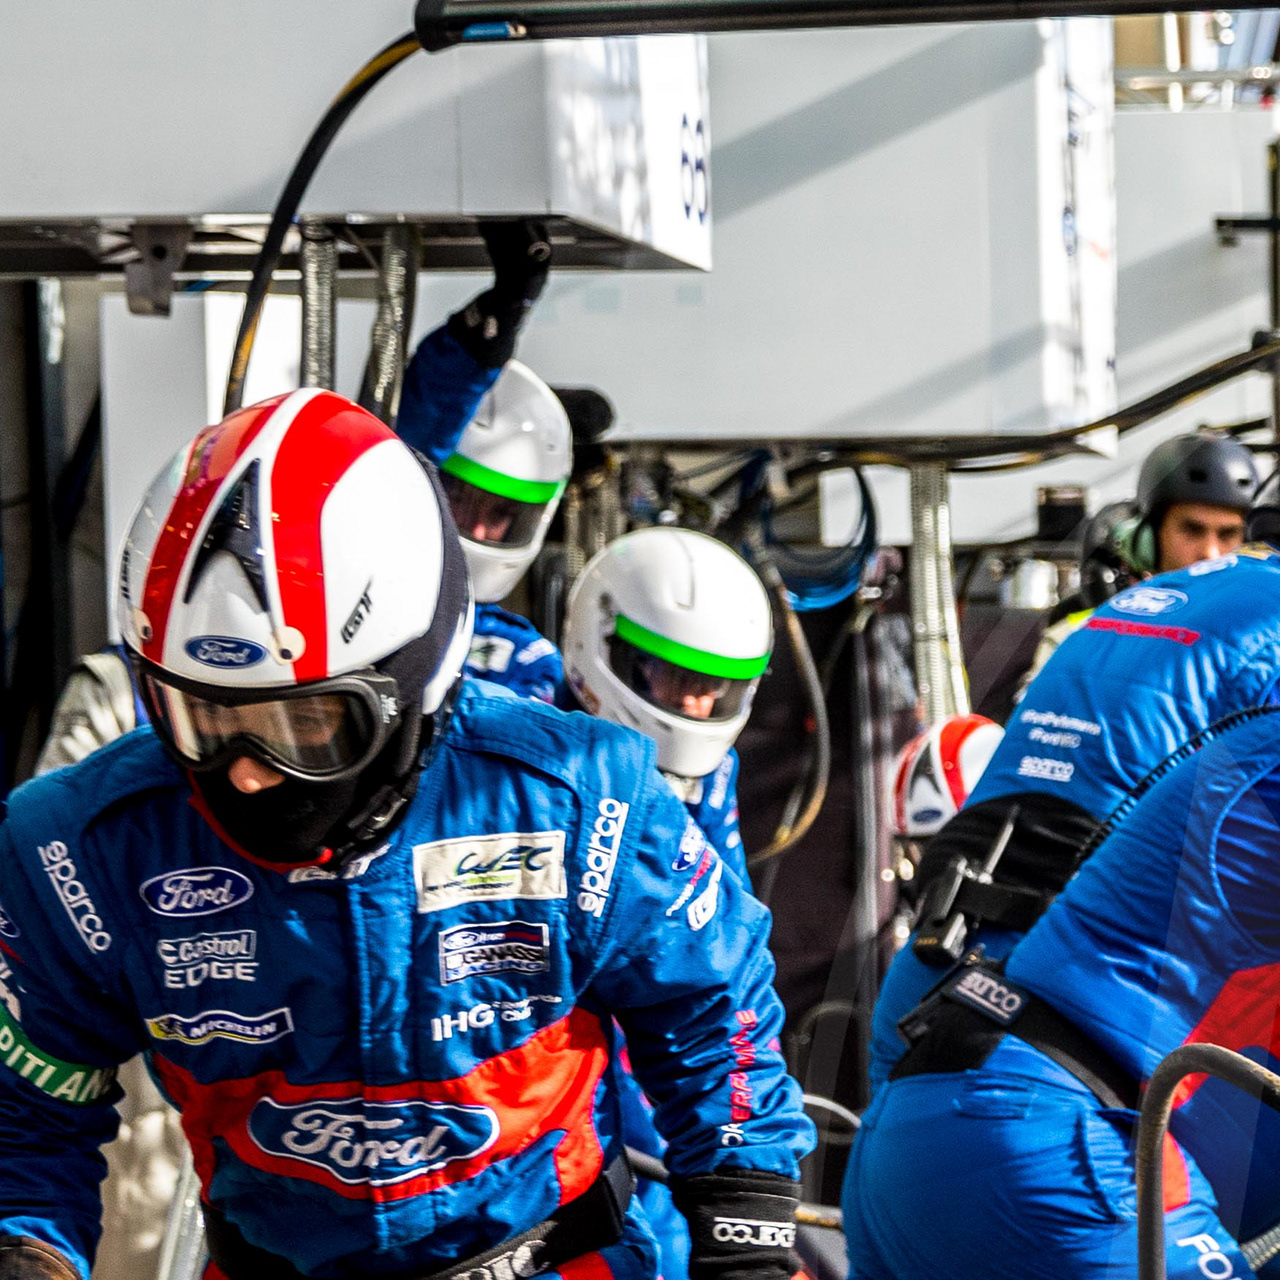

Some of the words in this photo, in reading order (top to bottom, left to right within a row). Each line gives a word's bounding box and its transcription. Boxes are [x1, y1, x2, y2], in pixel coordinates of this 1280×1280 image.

[577, 798, 630, 918] sparco
[38, 841, 112, 955] sparco
[157, 872, 237, 911] Ford
[178, 936, 249, 963] Castrol
[164, 962, 260, 989] EDGE
[188, 1020, 277, 1039] MICHELIN
[431, 1003, 495, 1042] IHG
[280, 1109, 448, 1169] Ford
[712, 1217, 796, 1248] parco
